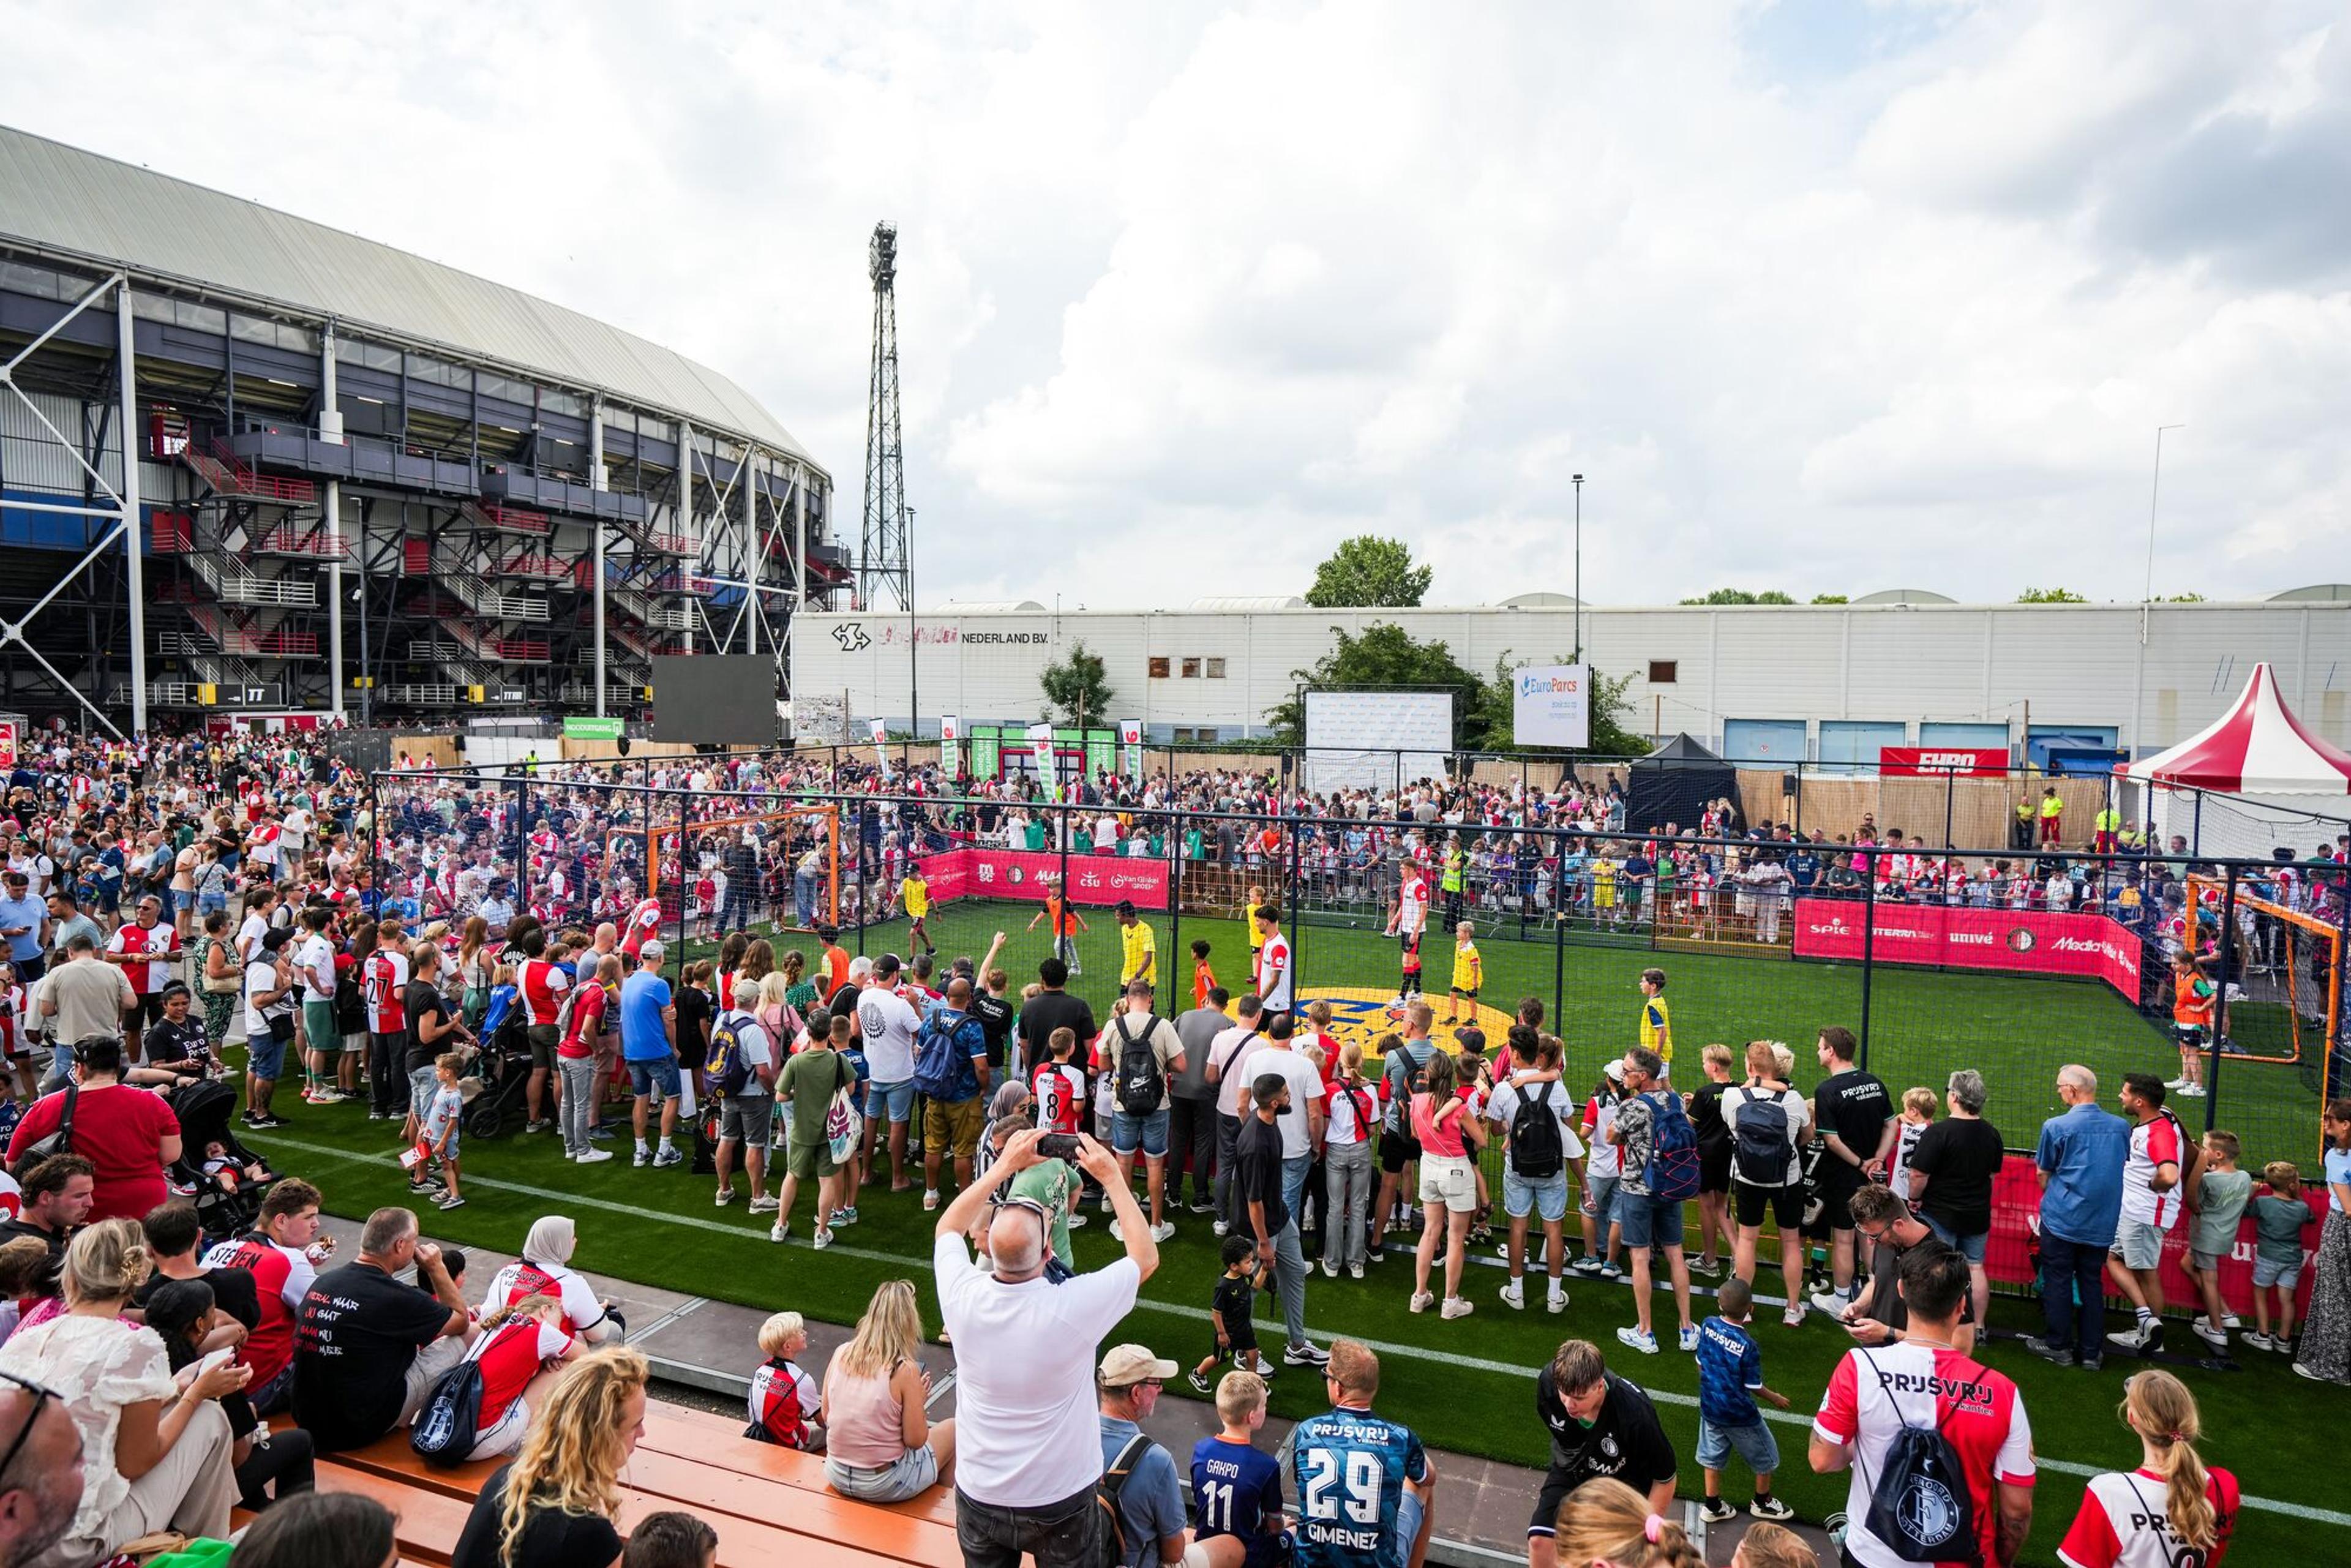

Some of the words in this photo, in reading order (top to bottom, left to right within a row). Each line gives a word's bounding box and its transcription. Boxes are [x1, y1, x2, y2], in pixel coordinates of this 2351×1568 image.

[962, 633, 1029, 643] NEDERLAND
[1531, 678, 1577, 692] EuroParcs
[1917, 752, 1976, 773] EHBO
[1080, 879, 1100, 887] CSU
[1873, 927, 1916, 937] ITERRA
[1949, 932, 1993, 944] univé
[367, 977, 388, 1004] 27
[184, 1039, 205, 1050] Euro
[1841, 1082, 1880, 1098] PRIJSVRIJ
[1047, 1093, 1059, 1120] 8
[1805, 1149, 1821, 1176] 7
[210, 1247, 263, 1269] STEVEN
[319, 1345, 343, 1356] MEE
[1879, 1371, 1993, 1405] PRIJSVRIJ
[1312, 1424, 1389, 1441] PRIJSVRIJ
[1207, 1458, 1239, 1479] GAKPO
[1307, 1448, 1384, 1523] 29
[1202, 1480, 1234, 1532] 11
[1308, 1524, 1379, 1551] GIMENEZ
